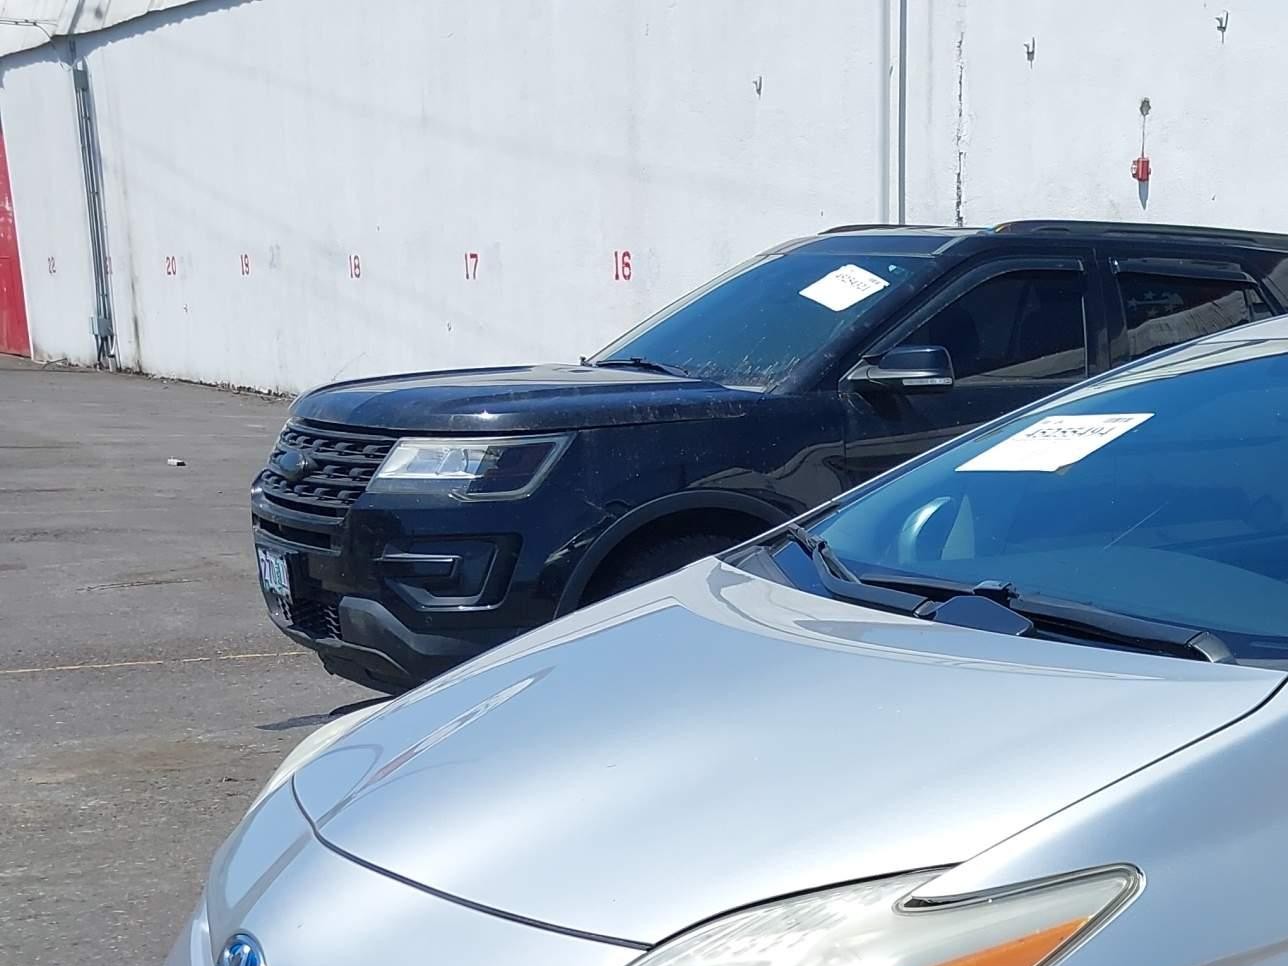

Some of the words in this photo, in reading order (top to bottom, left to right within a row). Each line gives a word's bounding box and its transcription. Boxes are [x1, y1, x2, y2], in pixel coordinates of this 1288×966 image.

[165, 255, 177, 276] 20
[348, 255, 362, 279] 18
[464, 252, 480, 280] 17
[613, 250, 633, 280] 16
